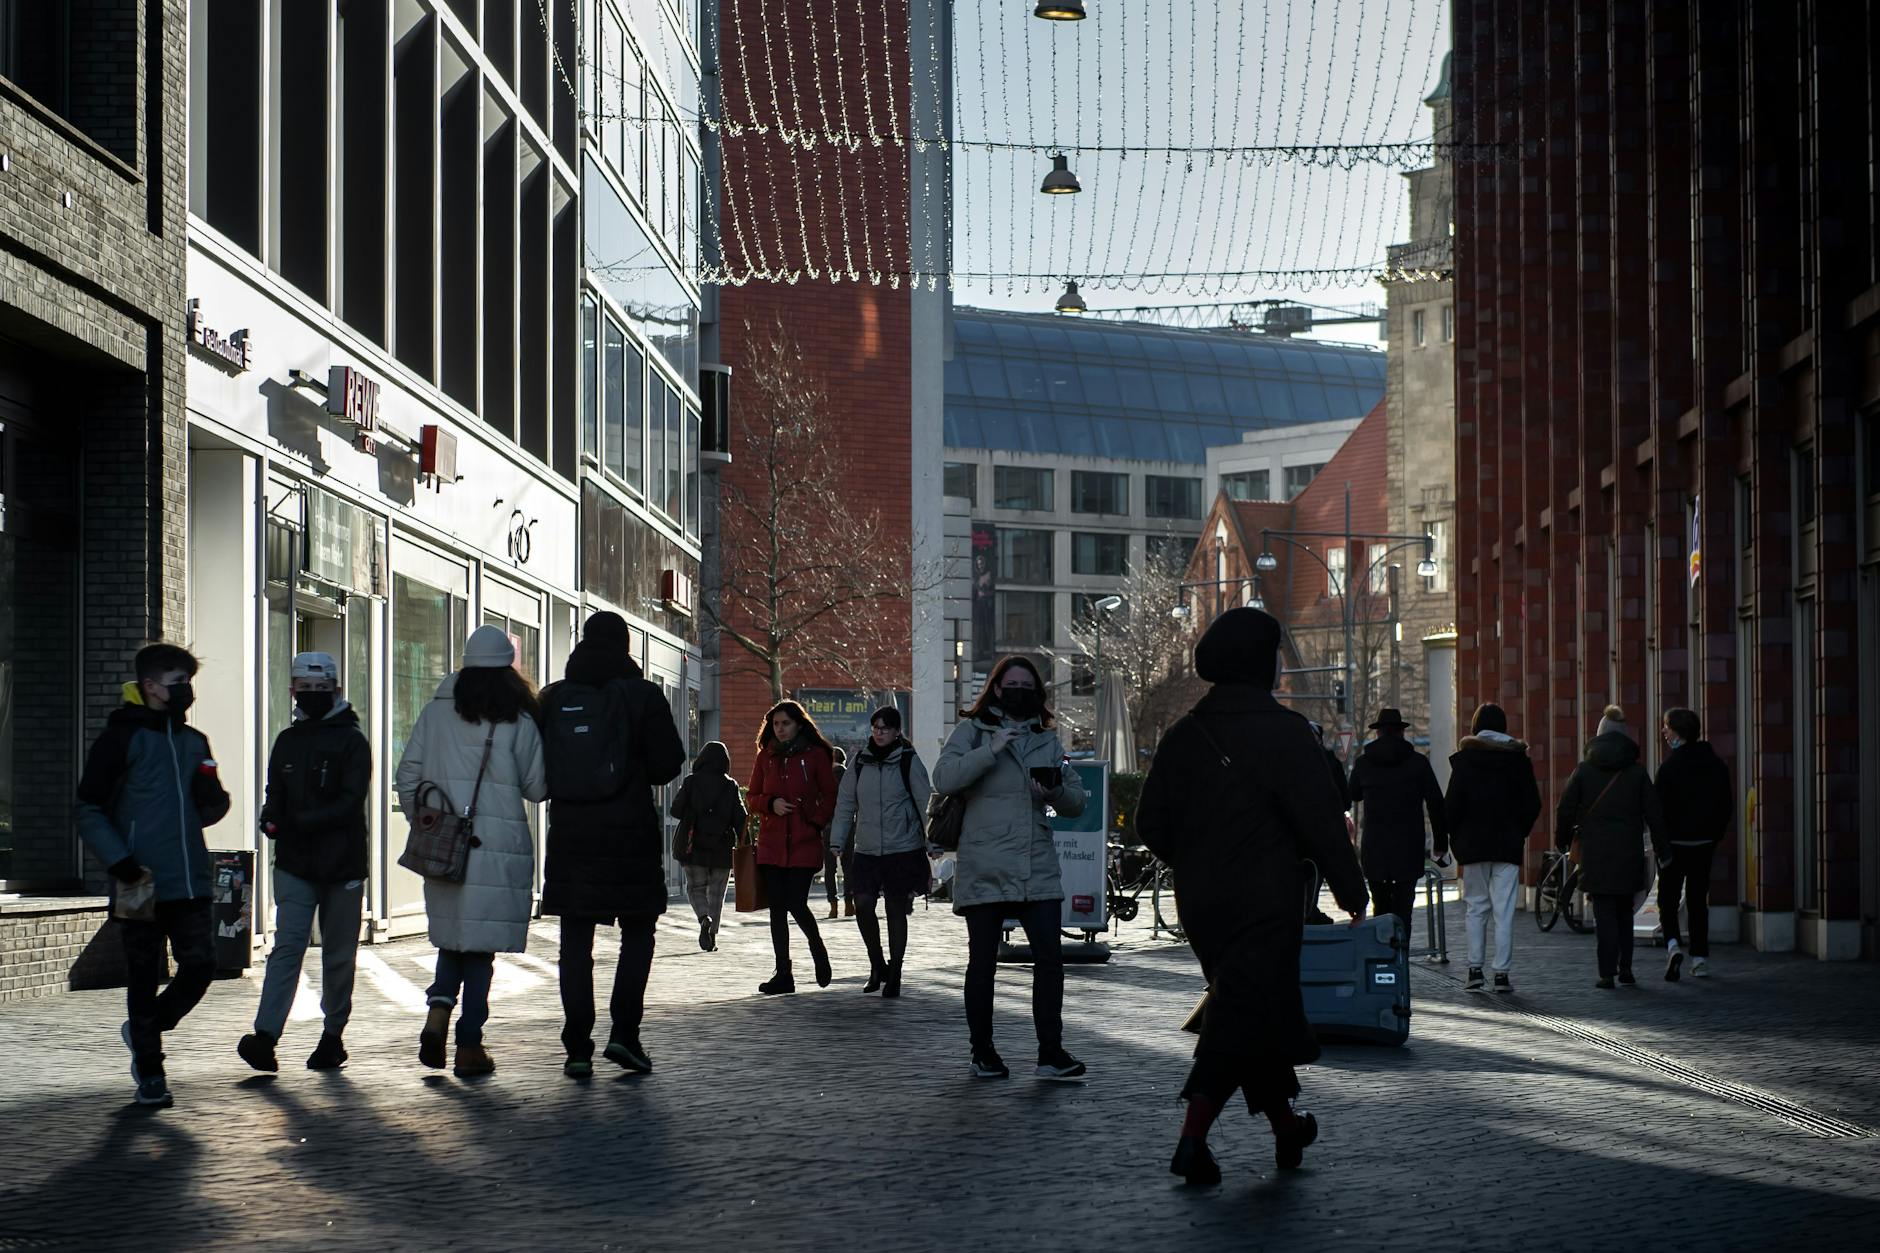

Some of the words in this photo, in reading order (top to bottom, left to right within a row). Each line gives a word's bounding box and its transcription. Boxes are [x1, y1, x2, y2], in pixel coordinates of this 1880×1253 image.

[345, 366, 380, 433] REWE
[807, 700, 835, 712] Hear
[845, 699, 868, 712] am!
[1063, 838, 1078, 849] mit
[1063, 850, 1095, 861] Maske!
